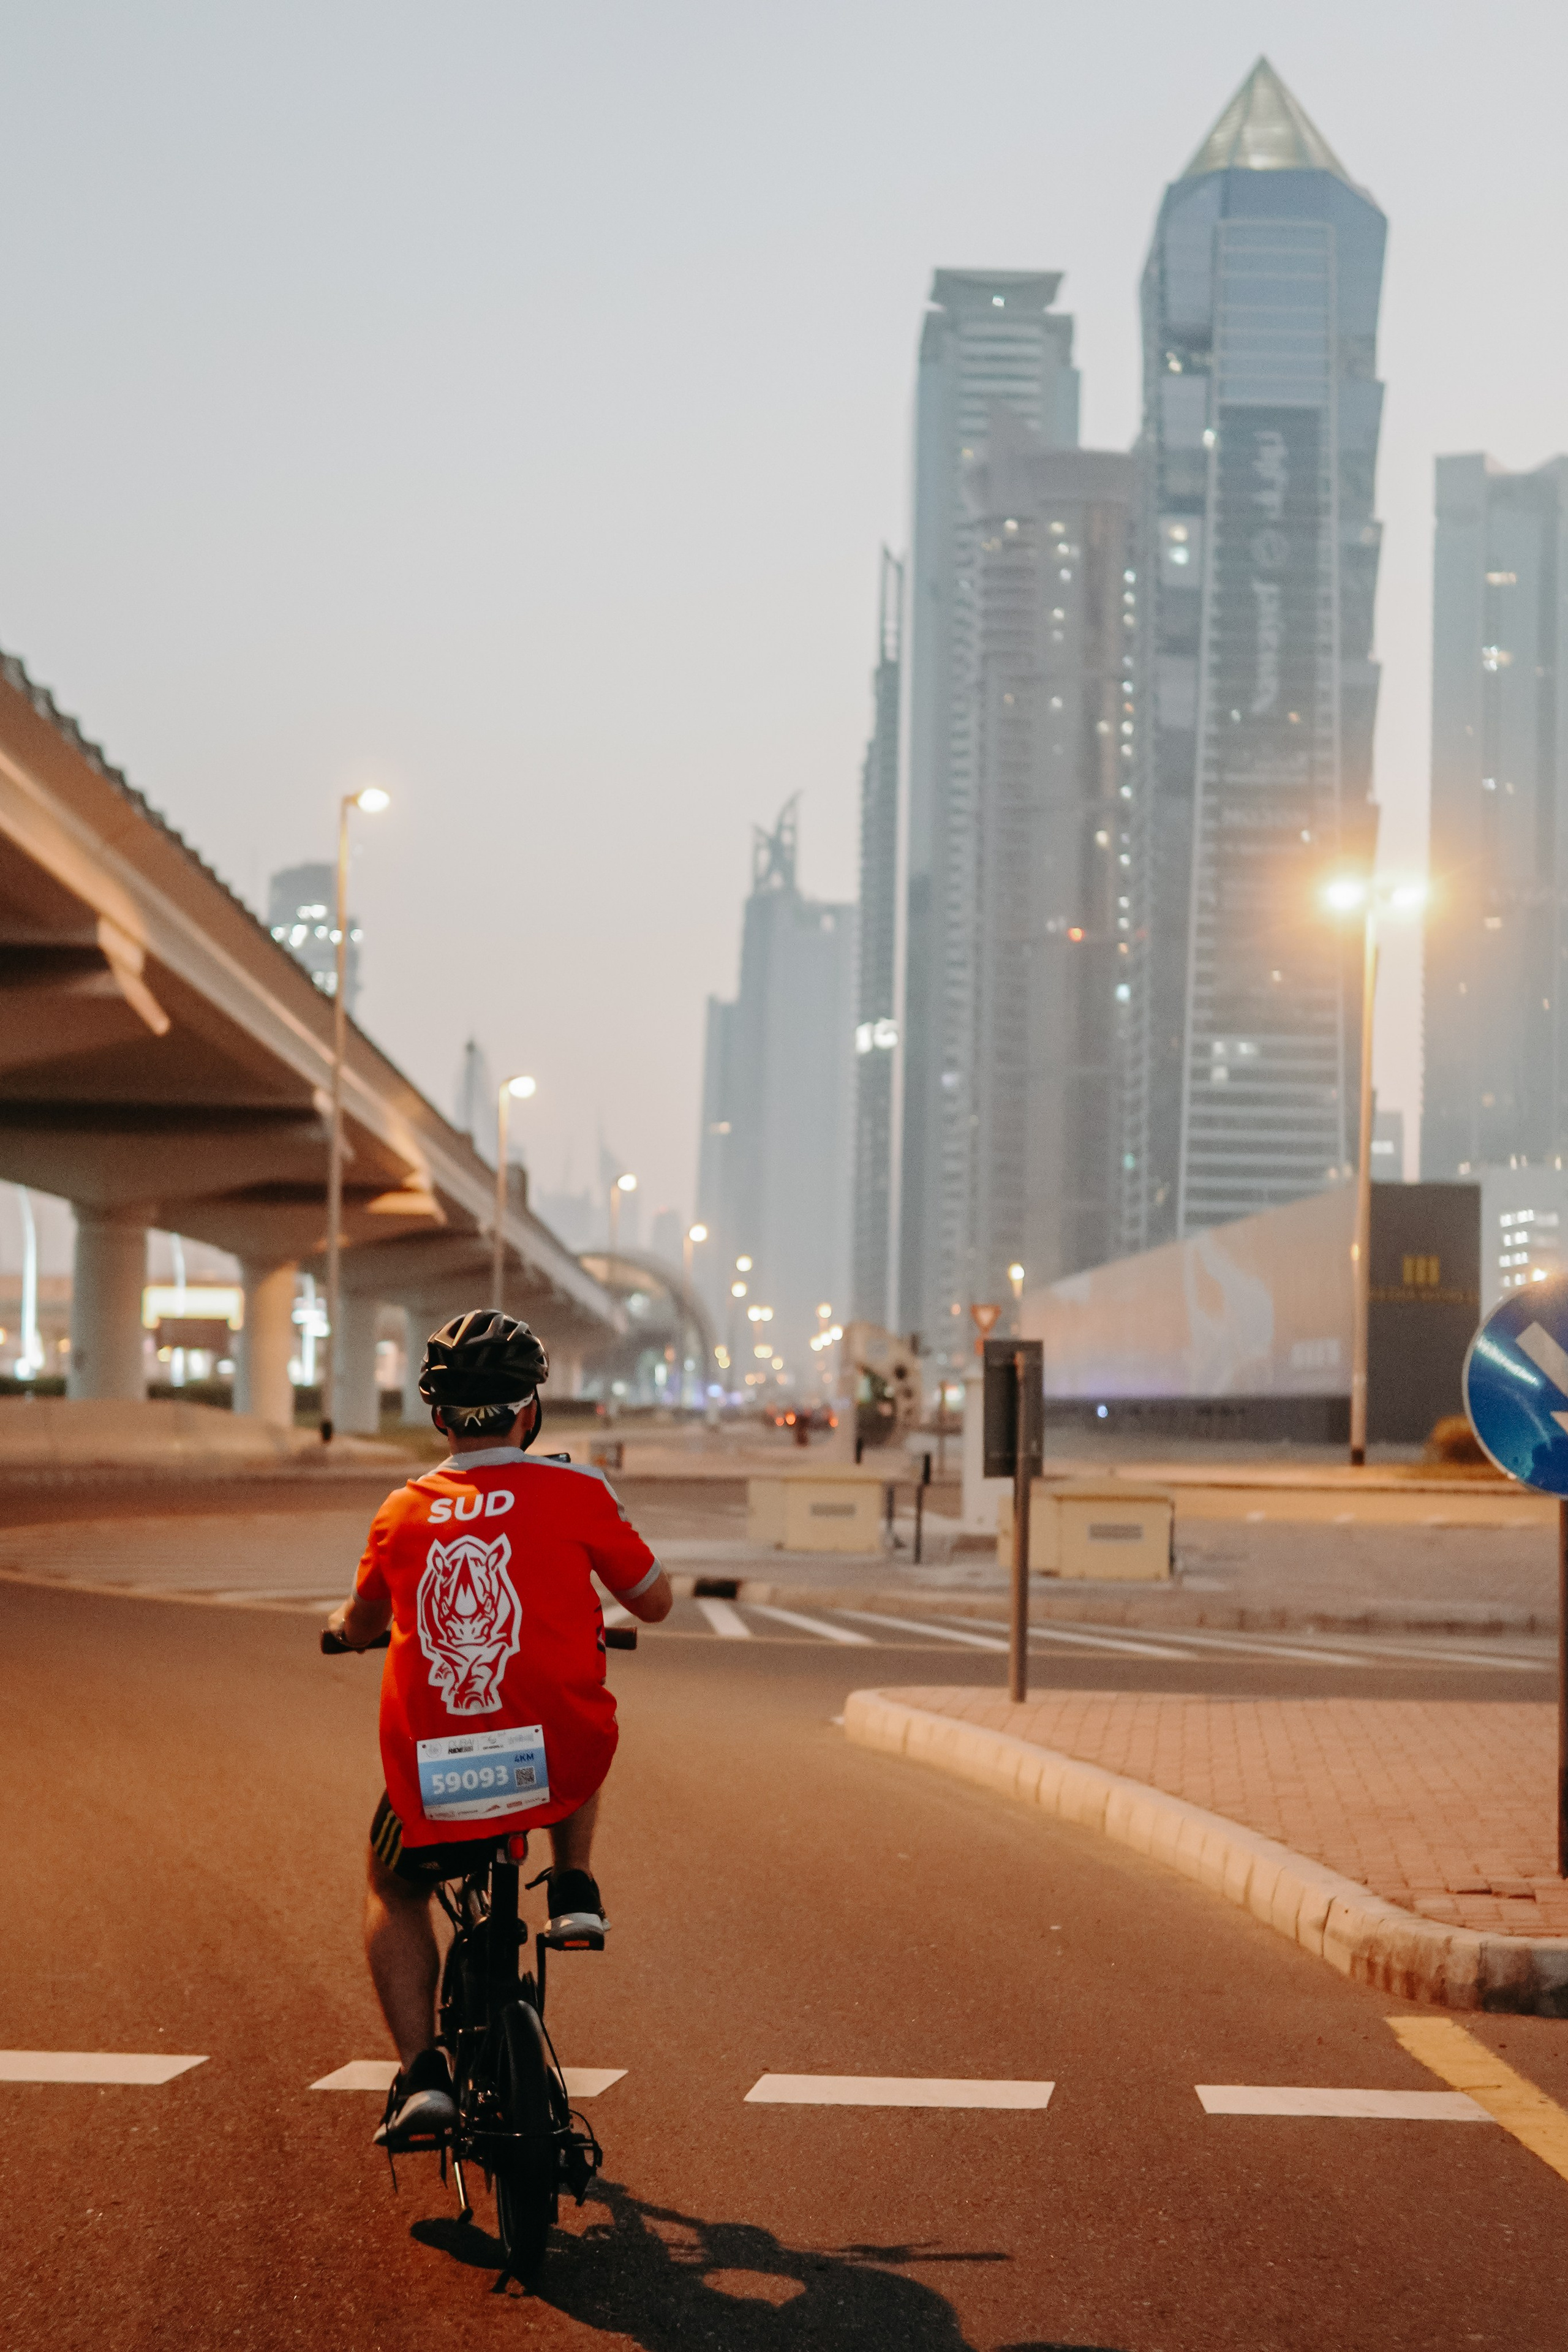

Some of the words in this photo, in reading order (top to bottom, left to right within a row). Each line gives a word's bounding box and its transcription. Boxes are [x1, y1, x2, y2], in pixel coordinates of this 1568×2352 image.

[427, 1490, 515, 1524] SUD
[514, 1752, 535, 1763] 4KM
[432, 1765, 510, 1795] 59093
